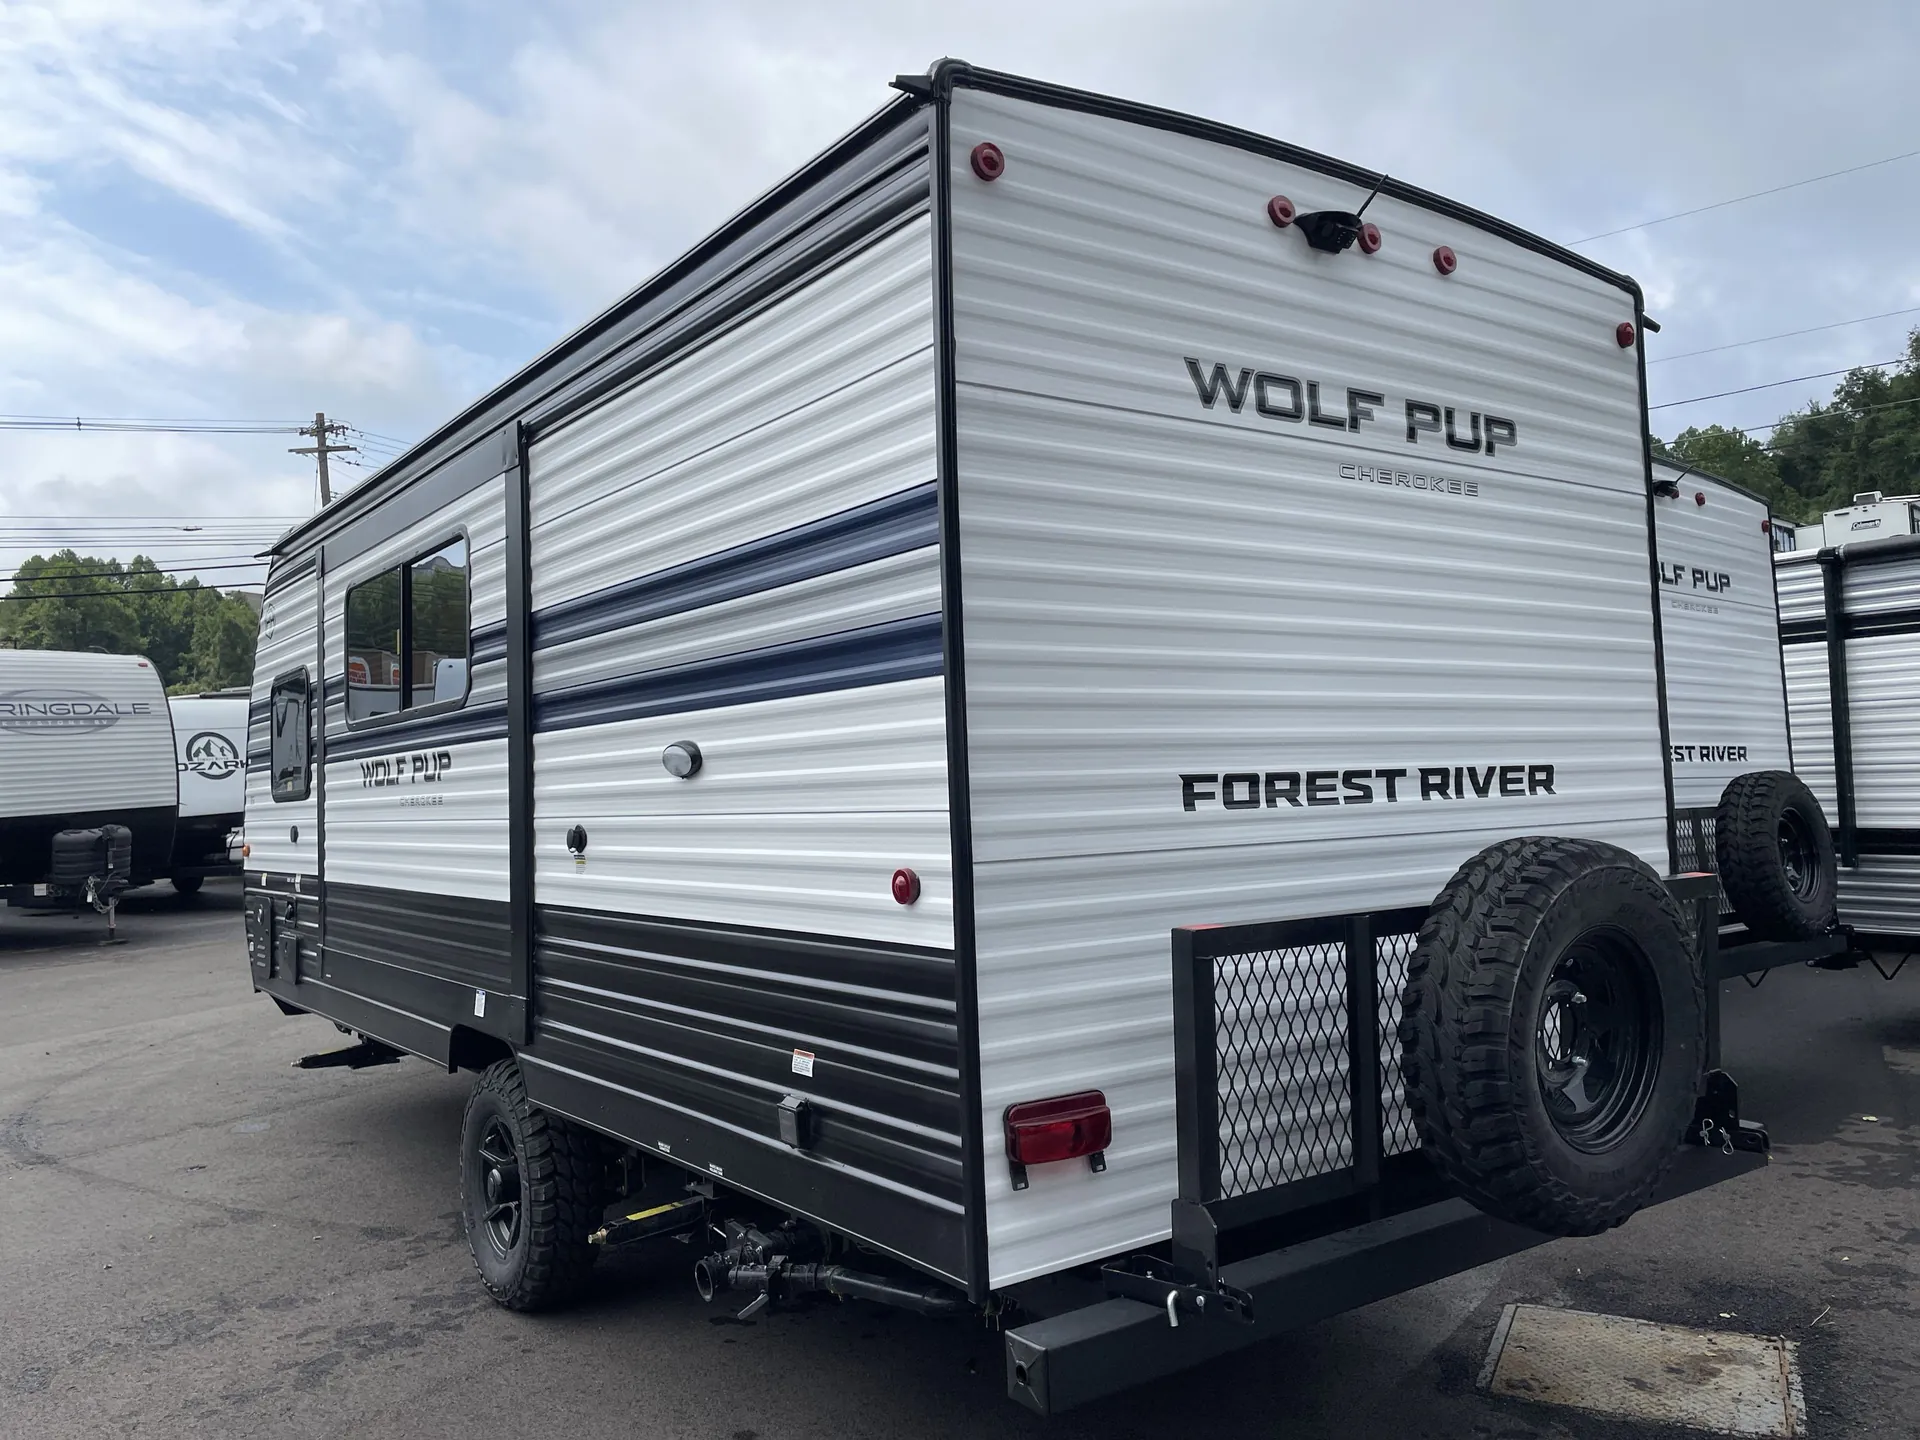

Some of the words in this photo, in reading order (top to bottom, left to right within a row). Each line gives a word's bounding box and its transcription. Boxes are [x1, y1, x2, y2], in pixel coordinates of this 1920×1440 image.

[1184, 356, 1385, 434] WOLF
[1405, 398, 1517, 457] PUP
[1339, 462, 1479, 497] CHEROKEE
[1657, 561, 1686, 586] LF
[1692, 567, 1731, 594] PUP
[0, 702, 152, 716] RINGDALE
[360, 755, 407, 789] WOLF
[411, 750, 452, 784] PUP
[1670, 745, 1696, 762] ST
[1699, 745, 1748, 762] RIVER
[1178, 767, 1408, 812] FOREST
[1417, 763, 1557, 801] RIVER
